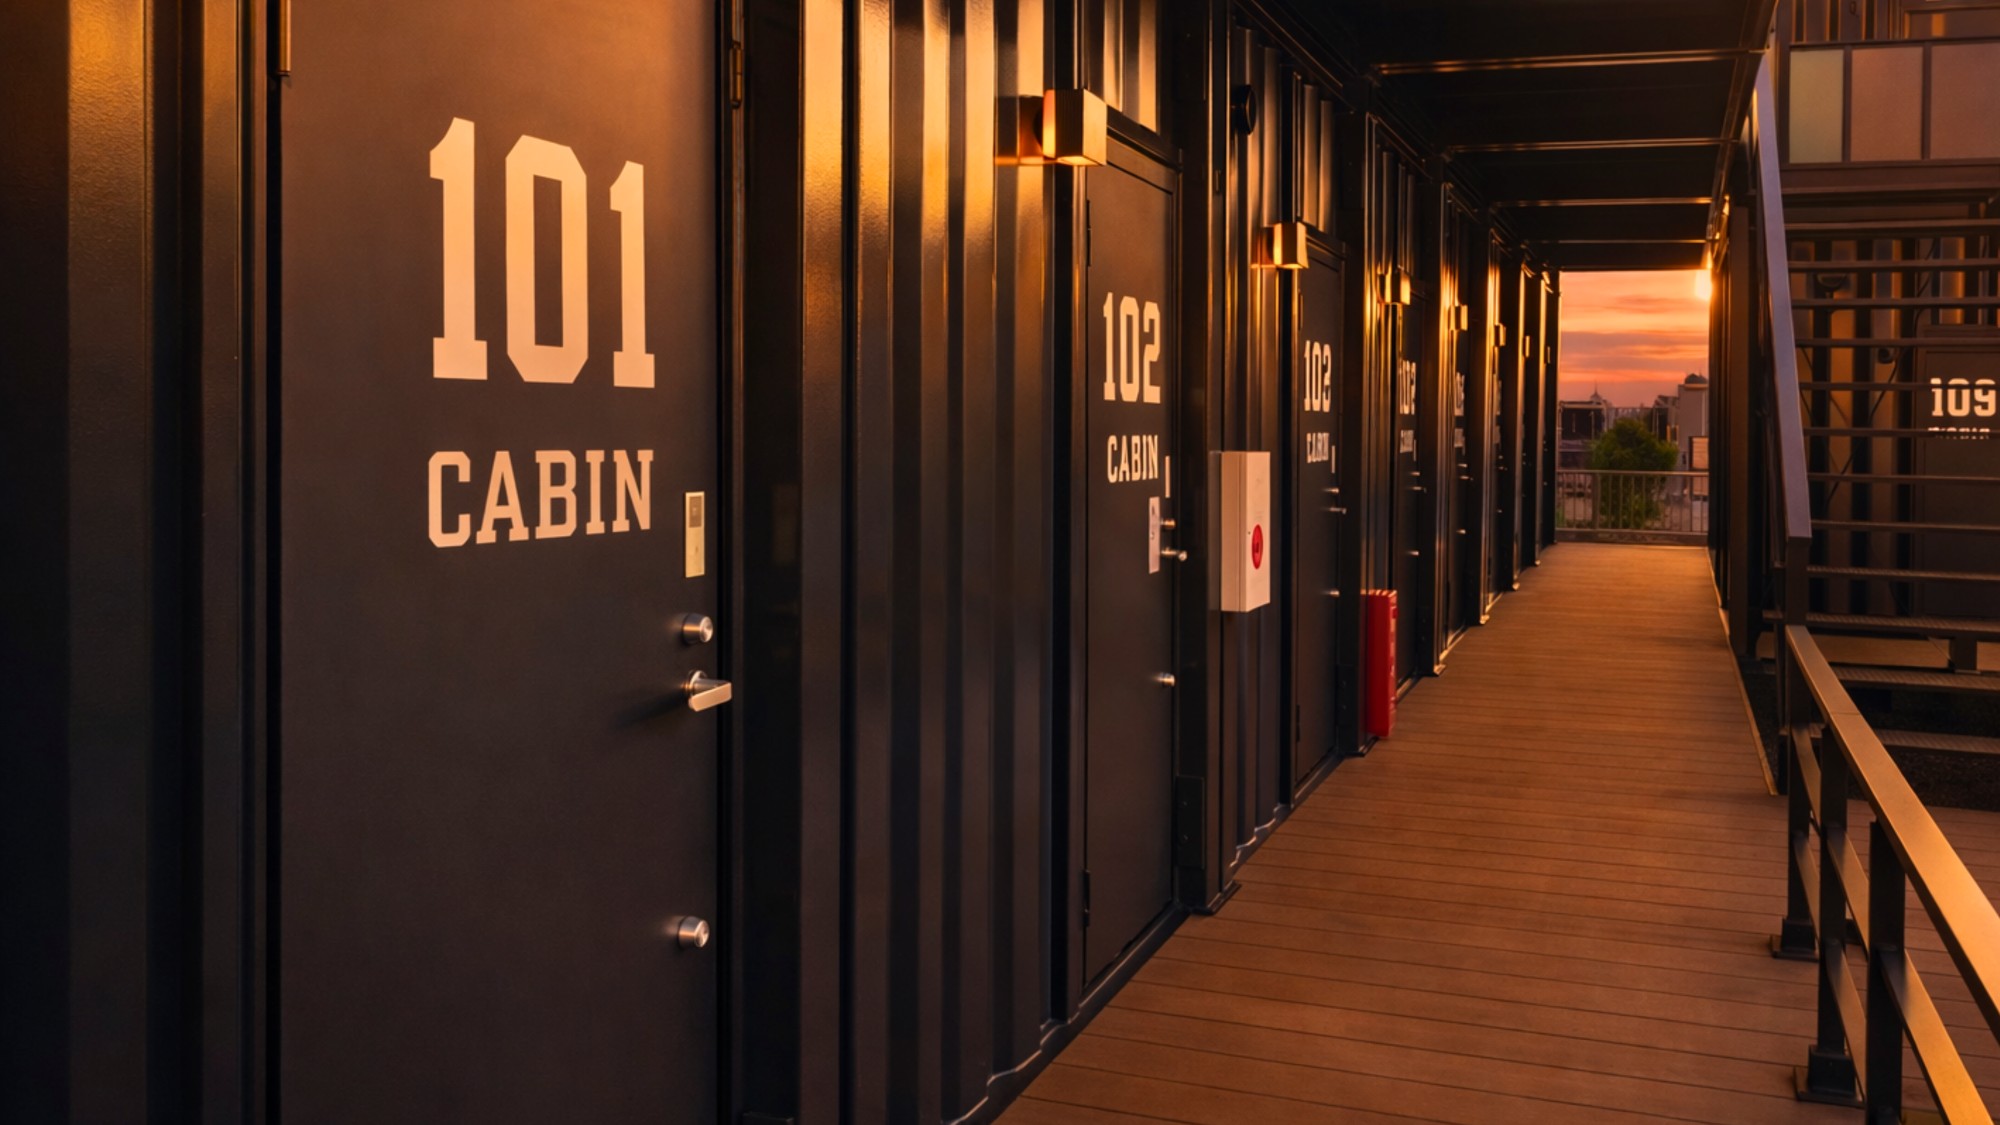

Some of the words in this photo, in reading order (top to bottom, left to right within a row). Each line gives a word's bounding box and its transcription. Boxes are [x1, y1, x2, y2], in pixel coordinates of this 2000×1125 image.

[430, 117, 655, 388] 101
[1103, 292, 1160, 404] 102
[1304, 340, 1331, 413] 103
[1930, 378, 1996, 416] 109
[428, 449, 654, 548] CABIN
[1107, 435, 1158, 483] CABIN
